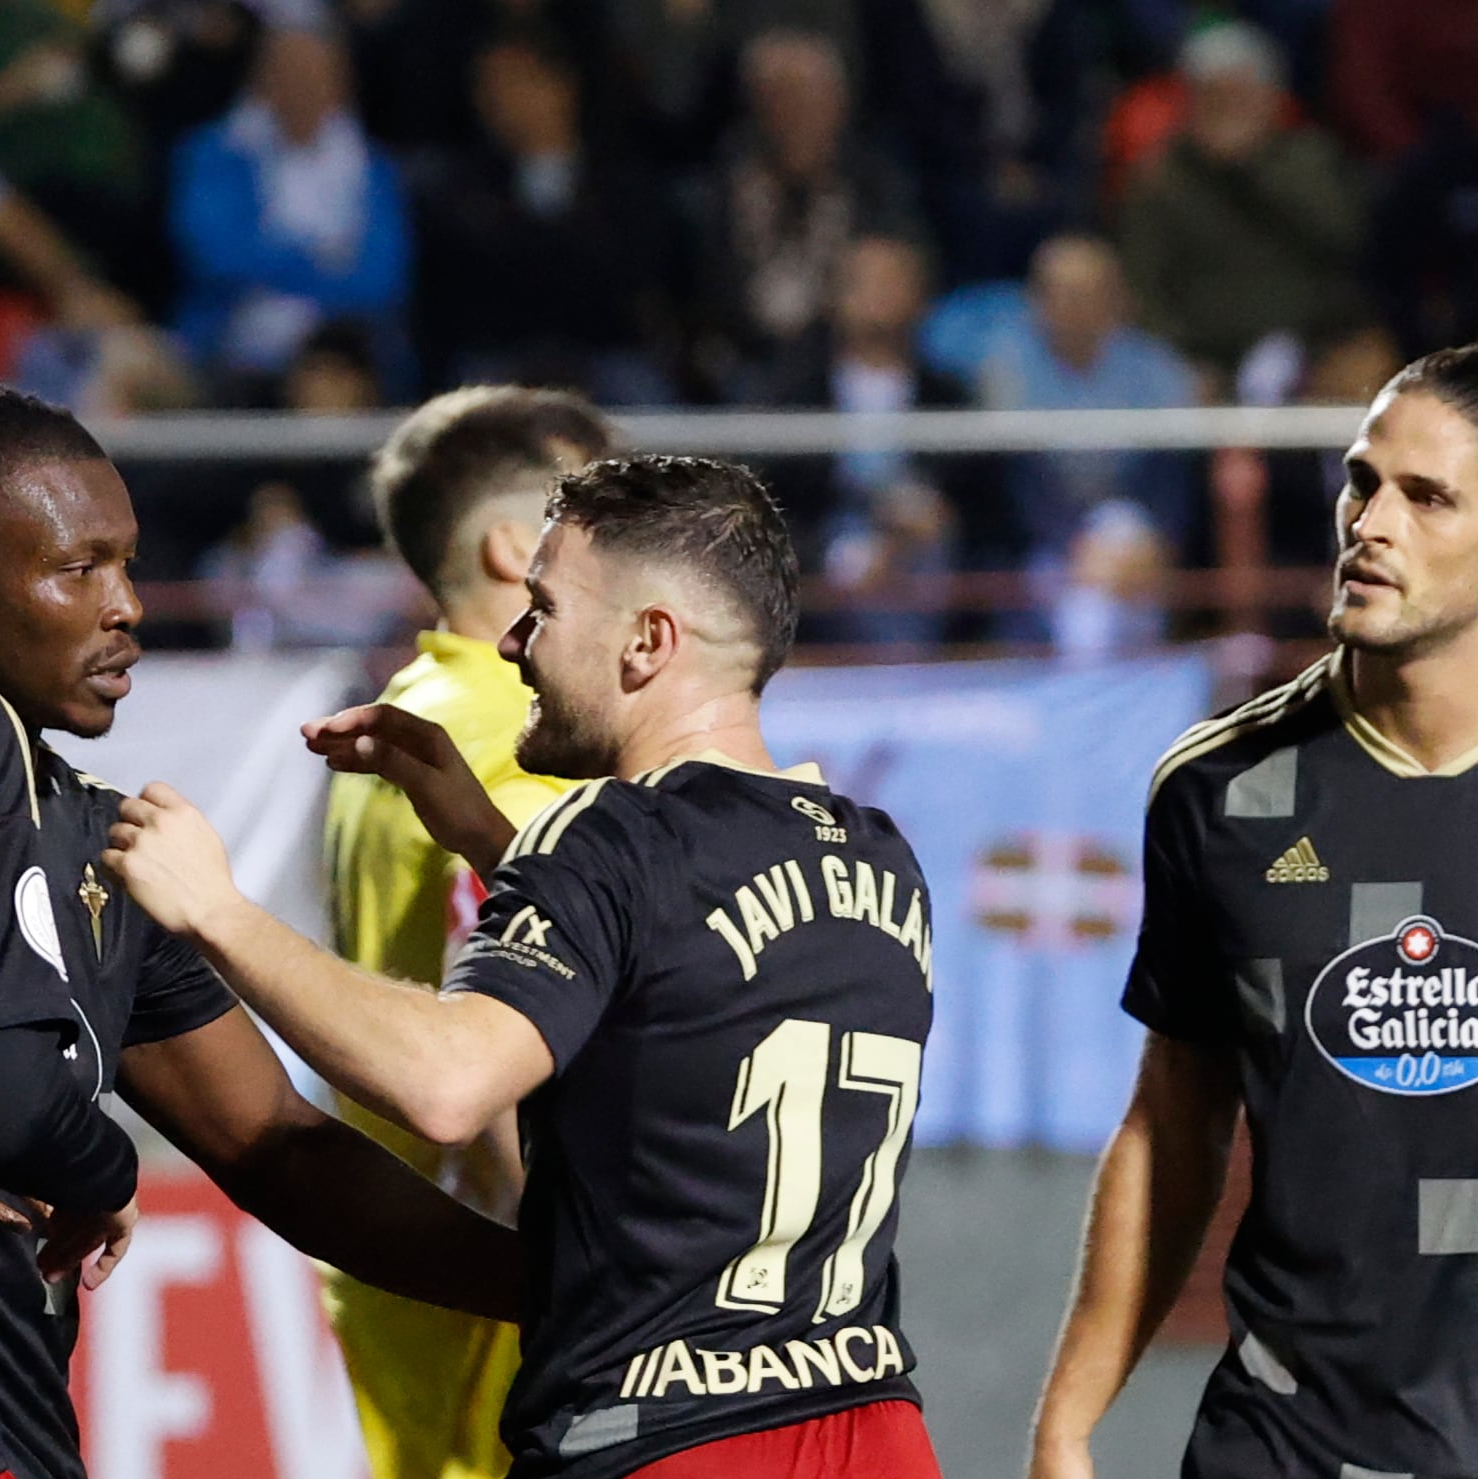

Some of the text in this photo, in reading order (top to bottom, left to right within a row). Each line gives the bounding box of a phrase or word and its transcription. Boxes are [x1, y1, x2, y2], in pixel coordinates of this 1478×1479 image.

[815, 825, 847, 844] 1923
[1266, 866, 1330, 884] adidas
[705, 859, 815, 981] JAVI
[715, 1017, 922, 1325] 17
[619, 1324, 905, 1399] ABANCA
